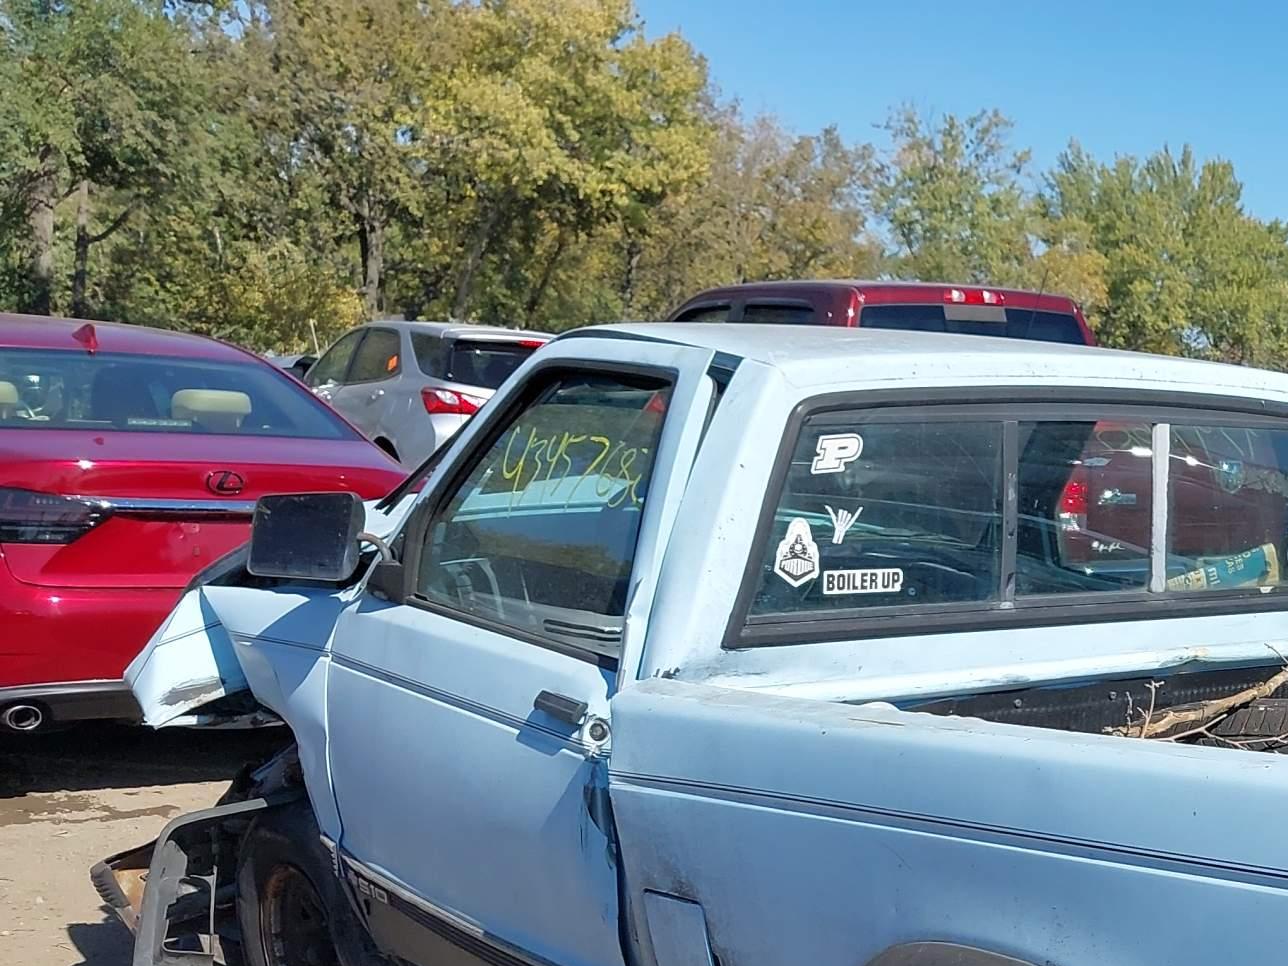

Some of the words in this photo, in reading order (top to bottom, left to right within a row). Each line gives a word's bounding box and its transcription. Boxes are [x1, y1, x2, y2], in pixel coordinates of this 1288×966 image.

[812, 434, 863, 473] P
[826, 572, 878, 591] BOILER
[881, 571, 901, 589] UP
